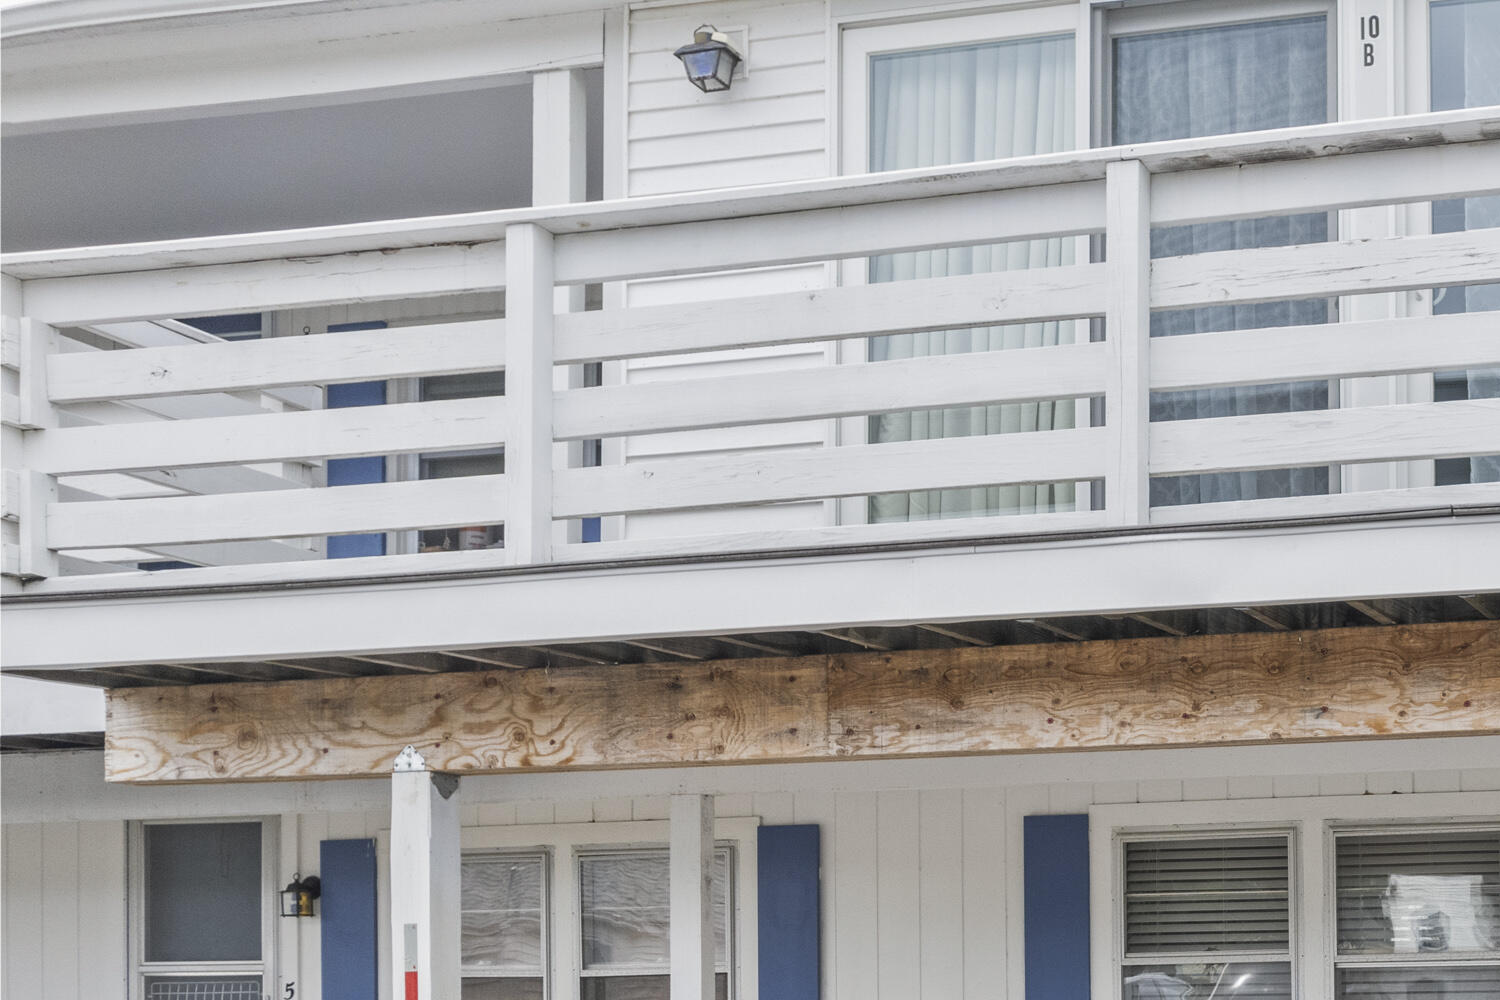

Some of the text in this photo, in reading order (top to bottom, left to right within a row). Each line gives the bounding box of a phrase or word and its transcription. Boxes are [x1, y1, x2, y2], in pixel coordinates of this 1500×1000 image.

[1361, 16, 1380, 40] 10
[1364, 43, 1375, 67] B
[284, 981, 295, 1000] 5
